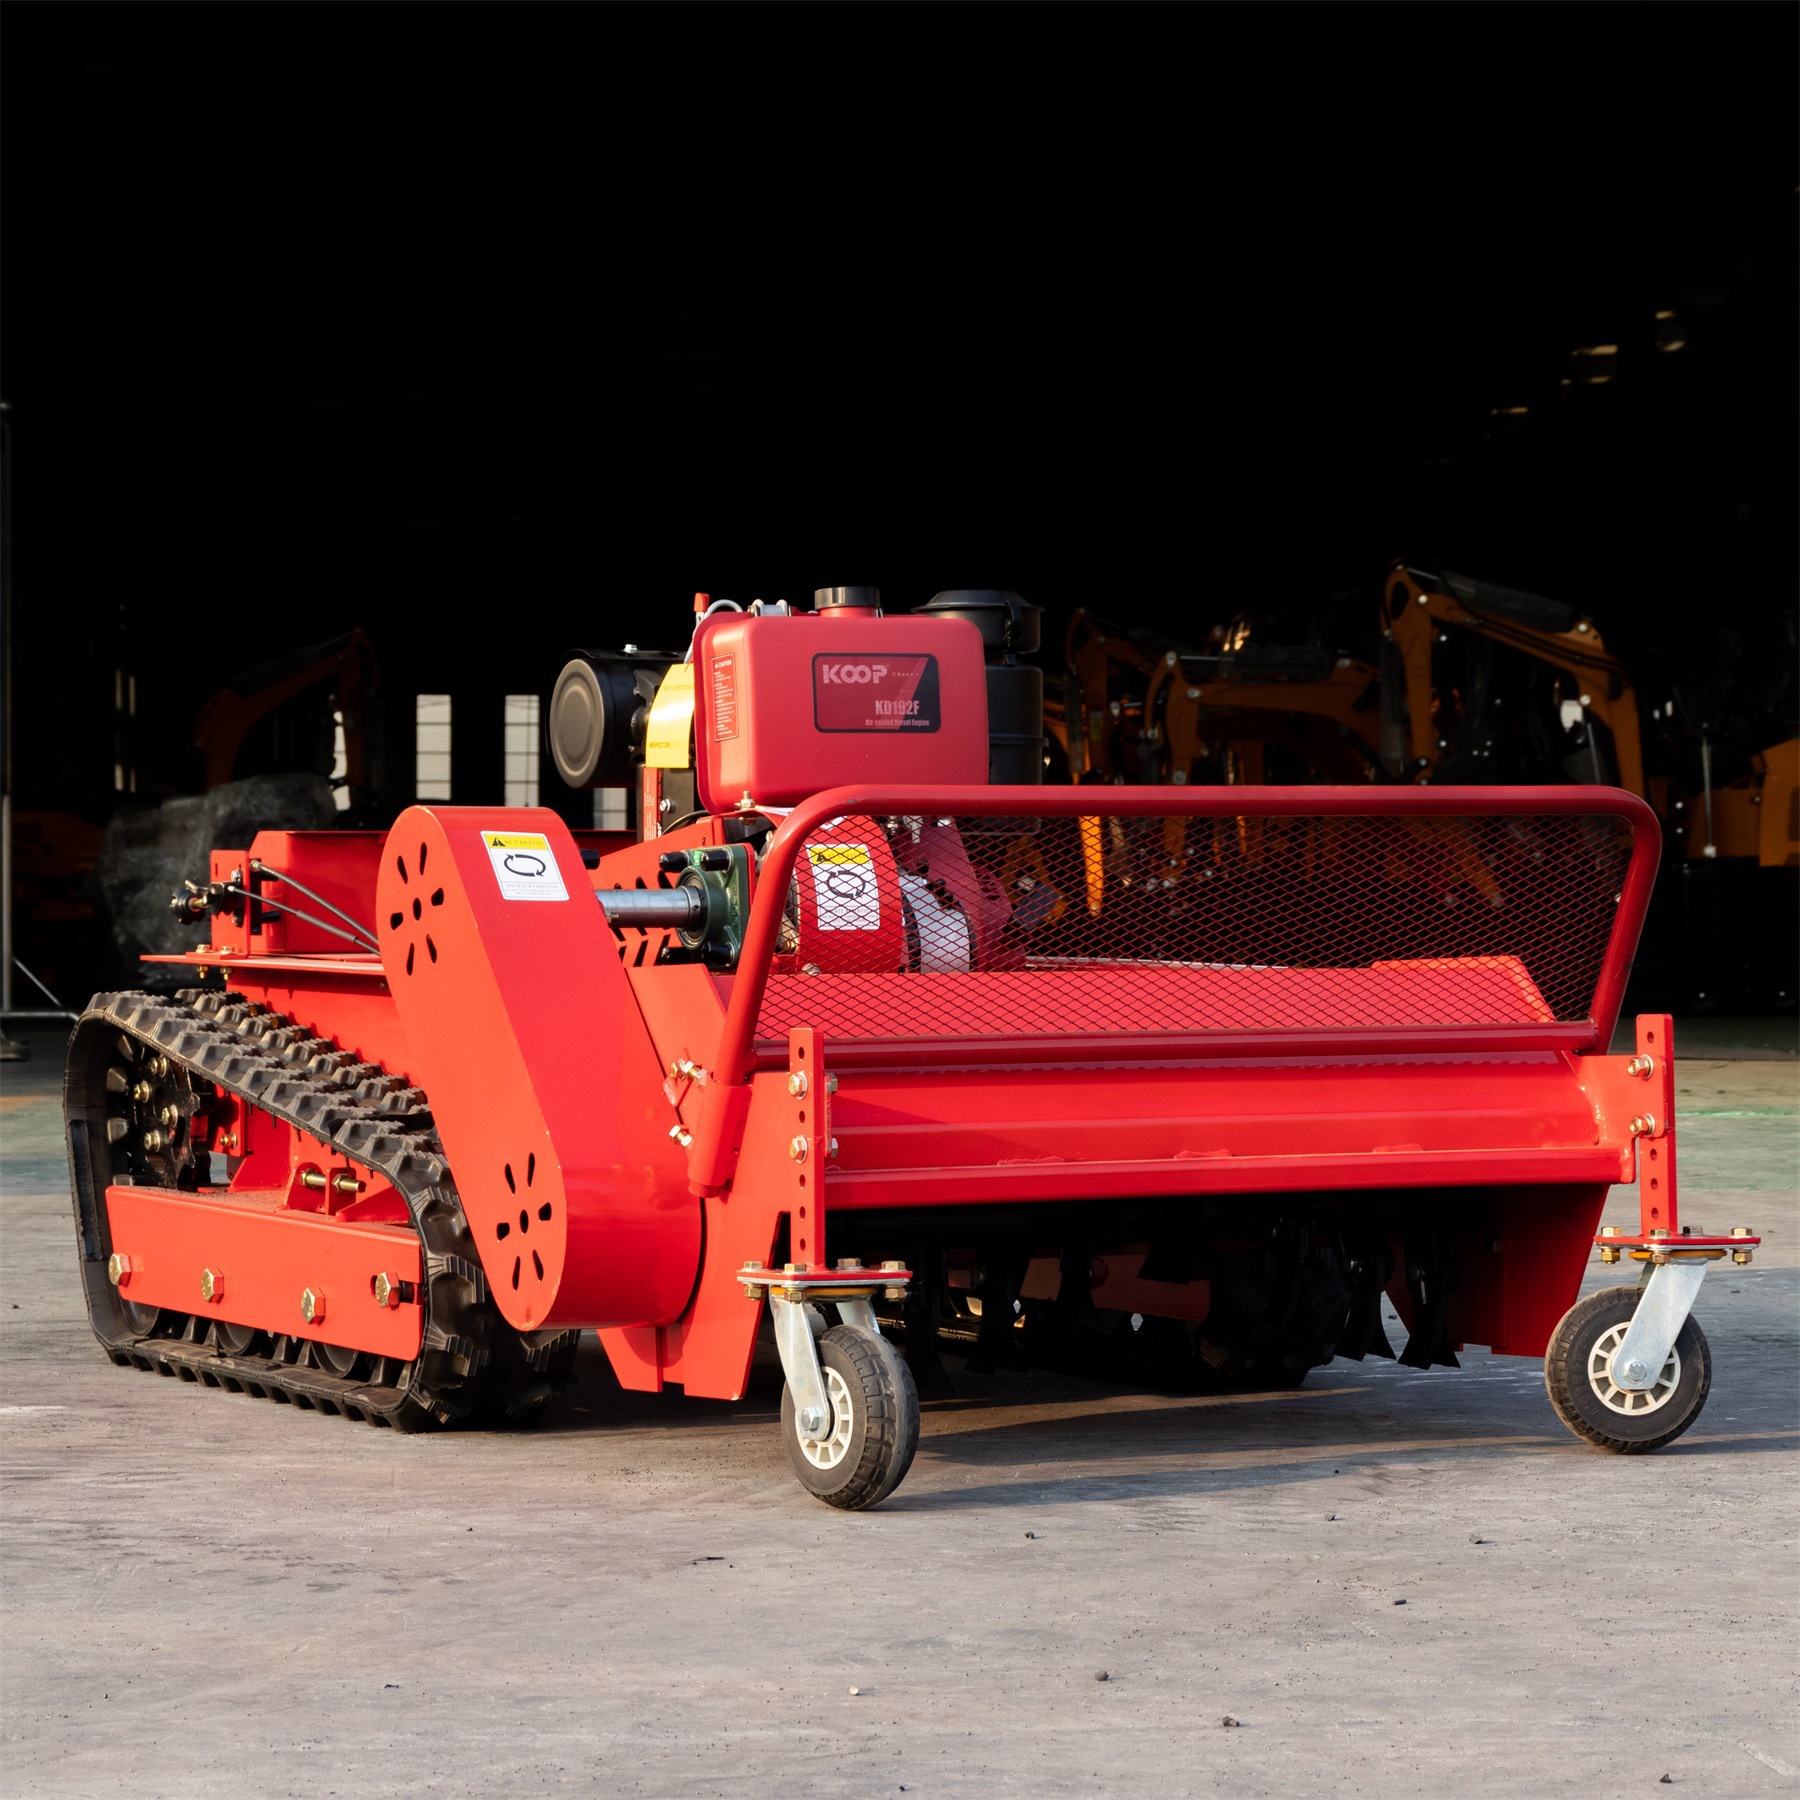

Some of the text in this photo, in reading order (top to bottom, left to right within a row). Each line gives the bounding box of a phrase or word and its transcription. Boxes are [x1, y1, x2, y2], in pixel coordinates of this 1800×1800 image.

[822, 664, 888, 684] KOOP
[875, 700, 920, 715] KD192F
[911, 719, 930, 727] Engine
